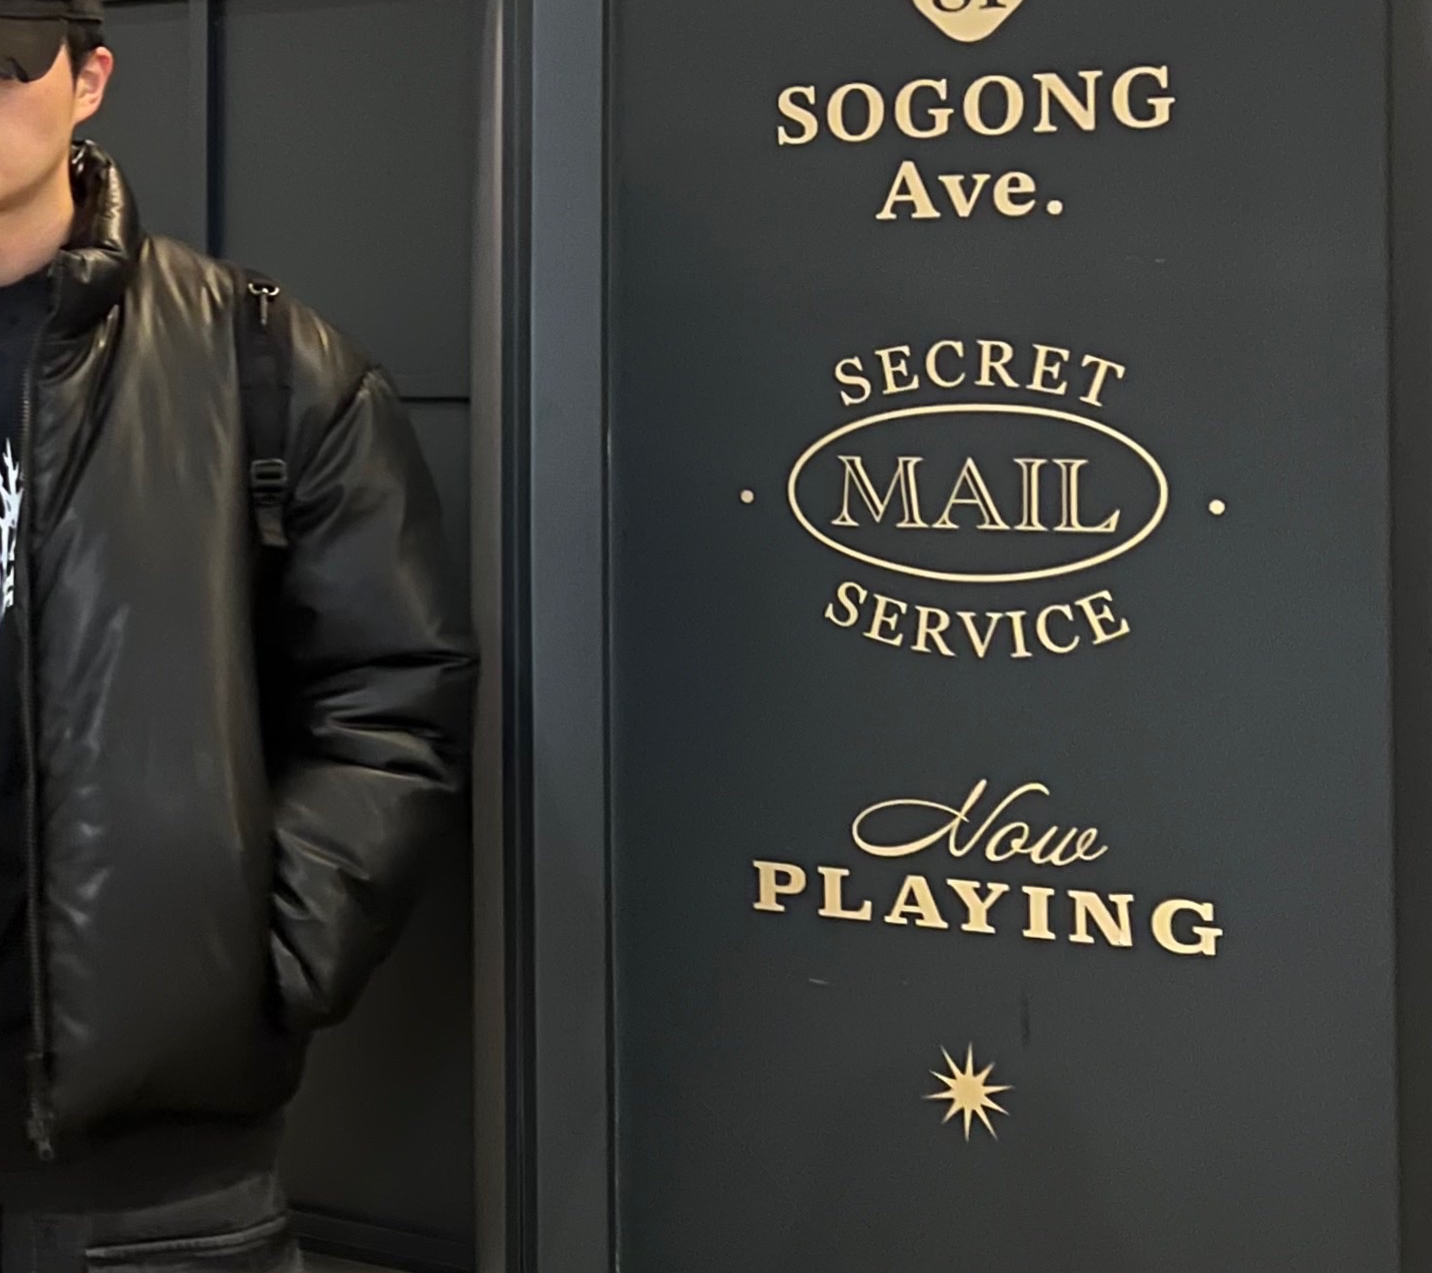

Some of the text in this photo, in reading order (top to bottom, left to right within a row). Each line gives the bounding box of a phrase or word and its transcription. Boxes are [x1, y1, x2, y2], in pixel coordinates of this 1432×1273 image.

[777, 65, 1176, 146] SOGONG
[875, 160, 1064, 220] Ave.
[834, 339, 1126, 407] SECRET
[830, 455, 1121, 533] MAIL
[824, 580, 1131, 659] SERVICE
[851, 778, 1109, 866] Now
[752, 859, 1224, 956] PLAYING
